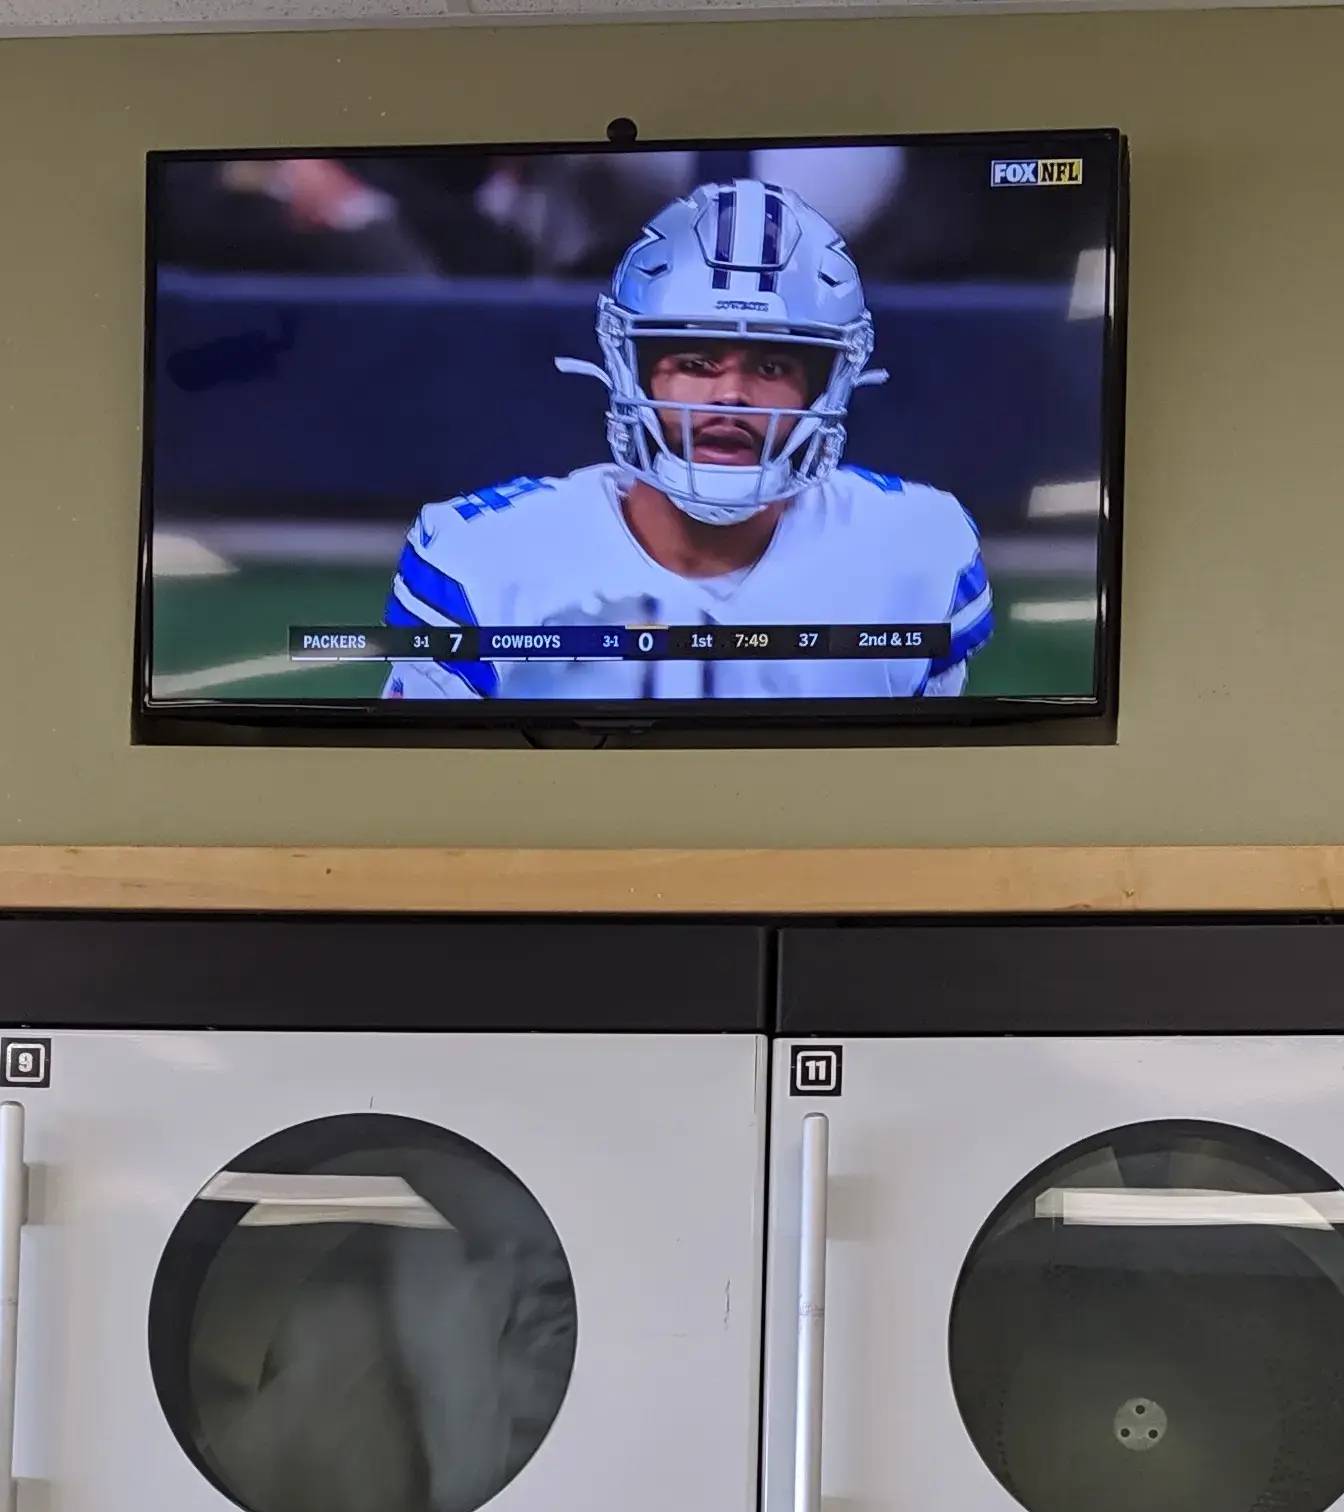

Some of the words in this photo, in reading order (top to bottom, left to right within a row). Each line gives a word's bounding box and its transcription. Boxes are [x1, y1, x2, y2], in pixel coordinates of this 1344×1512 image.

[995, 163, 1036, 183] FOX
[1040, 162, 1078, 182] NFL
[303, 635, 366, 649] PACKERS
[413, 636, 430, 648] 3-1
[449, 633, 463, 653] 7
[491, 635, 561, 649] COWBOYS
[603, 636, 619, 648] 3-1
[638, 633, 653, 652] 0
[691, 634, 713, 647] 1st
[735, 634, 769, 647] 7:49
[799, 633, 818, 646] 37
[859, 632, 887, 646] 2nd
[890, 633, 902, 646] &
[905, 632, 921, 646] 15
[18, 1052, 33, 1072] 9
[805, 1060, 826, 1080] 11
